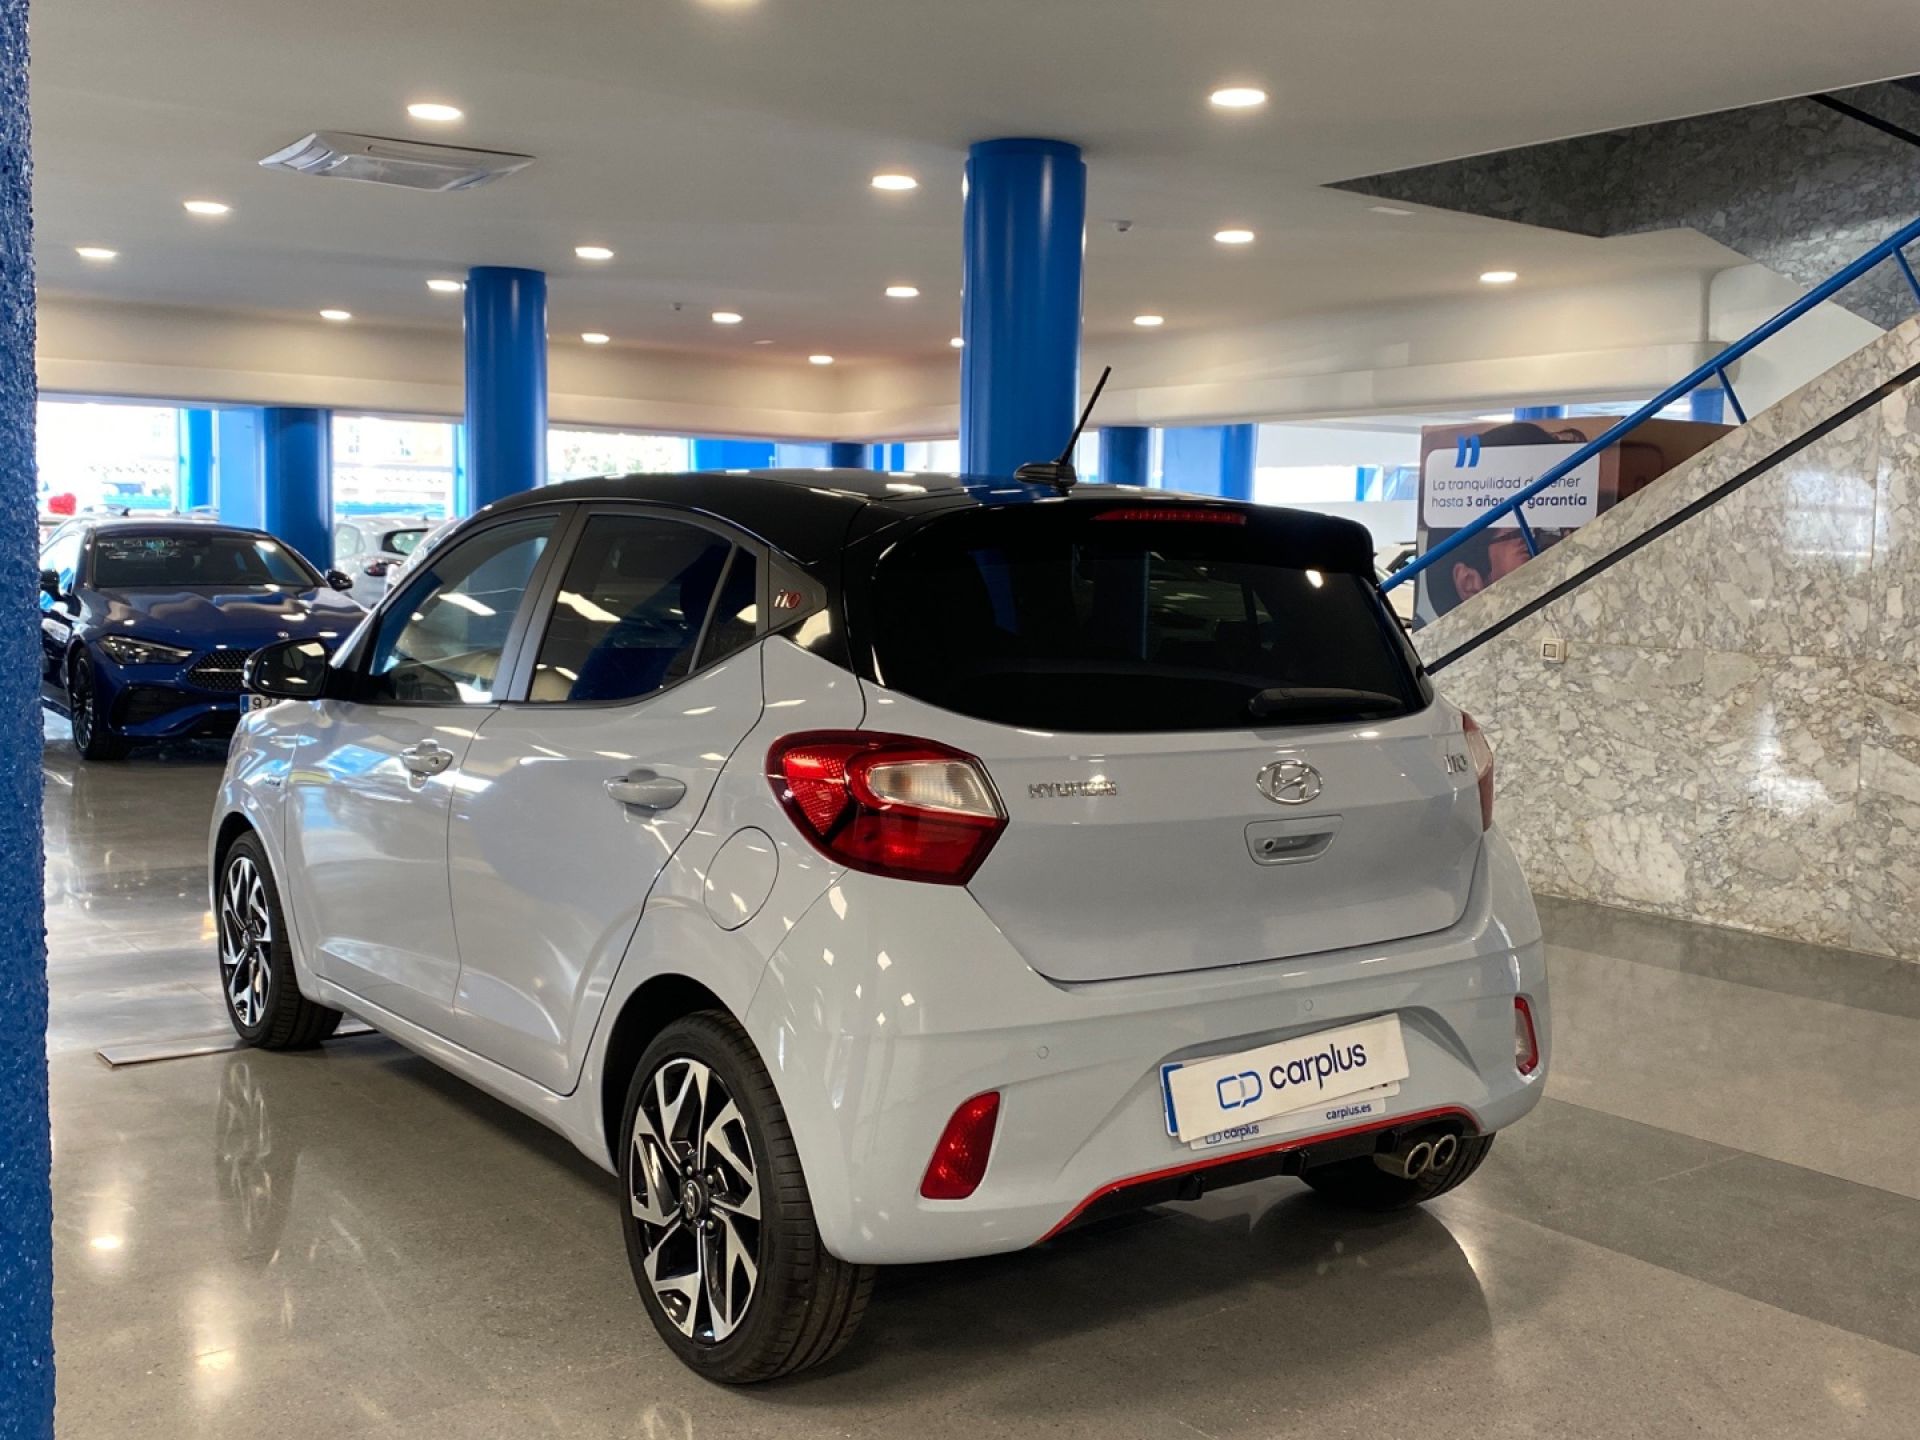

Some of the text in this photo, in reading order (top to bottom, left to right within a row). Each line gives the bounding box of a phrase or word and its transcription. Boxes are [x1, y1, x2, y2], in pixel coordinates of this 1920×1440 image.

[1432, 479, 1446, 491] La
[1448, 477, 1521, 491] tranquilidad
[1550, 477, 1581, 489] ener
[1432, 496, 1463, 508] hasta
[1466, 495, 1473, 507] 3
[1527, 493, 1587, 509] garantía
[773, 588, 801, 609] i10
[1027, 780, 1117, 798] HYUNDAI
[1269, 1043, 1367, 1091] carplus
[1326, 1103, 1372, 1119] carplus.es
[1223, 1124, 1260, 1141] carplus
